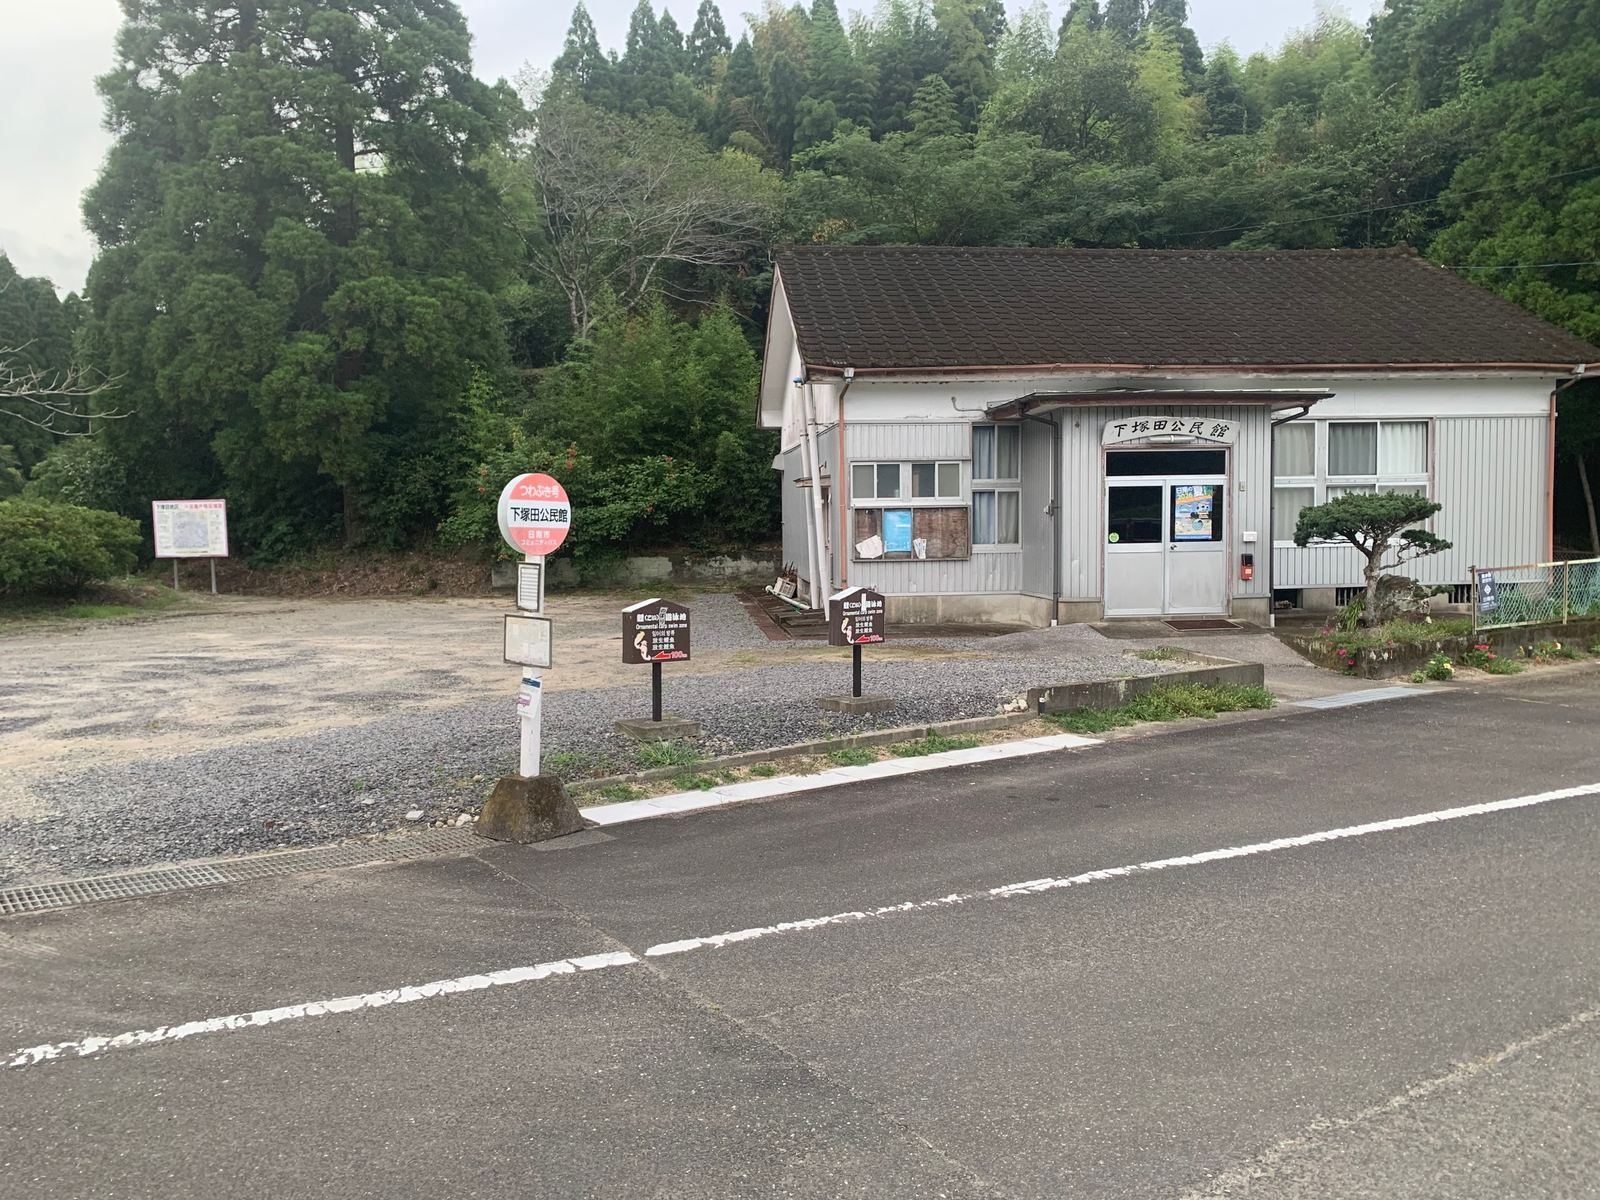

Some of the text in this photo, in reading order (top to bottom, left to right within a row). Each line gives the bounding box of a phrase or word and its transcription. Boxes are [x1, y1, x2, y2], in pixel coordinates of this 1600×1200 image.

[1114, 420, 1230, 438] 下塚田公民館
[520, 485, 559, 498] つわぶき号
[510, 507, 568, 522] 下塚田公民館
